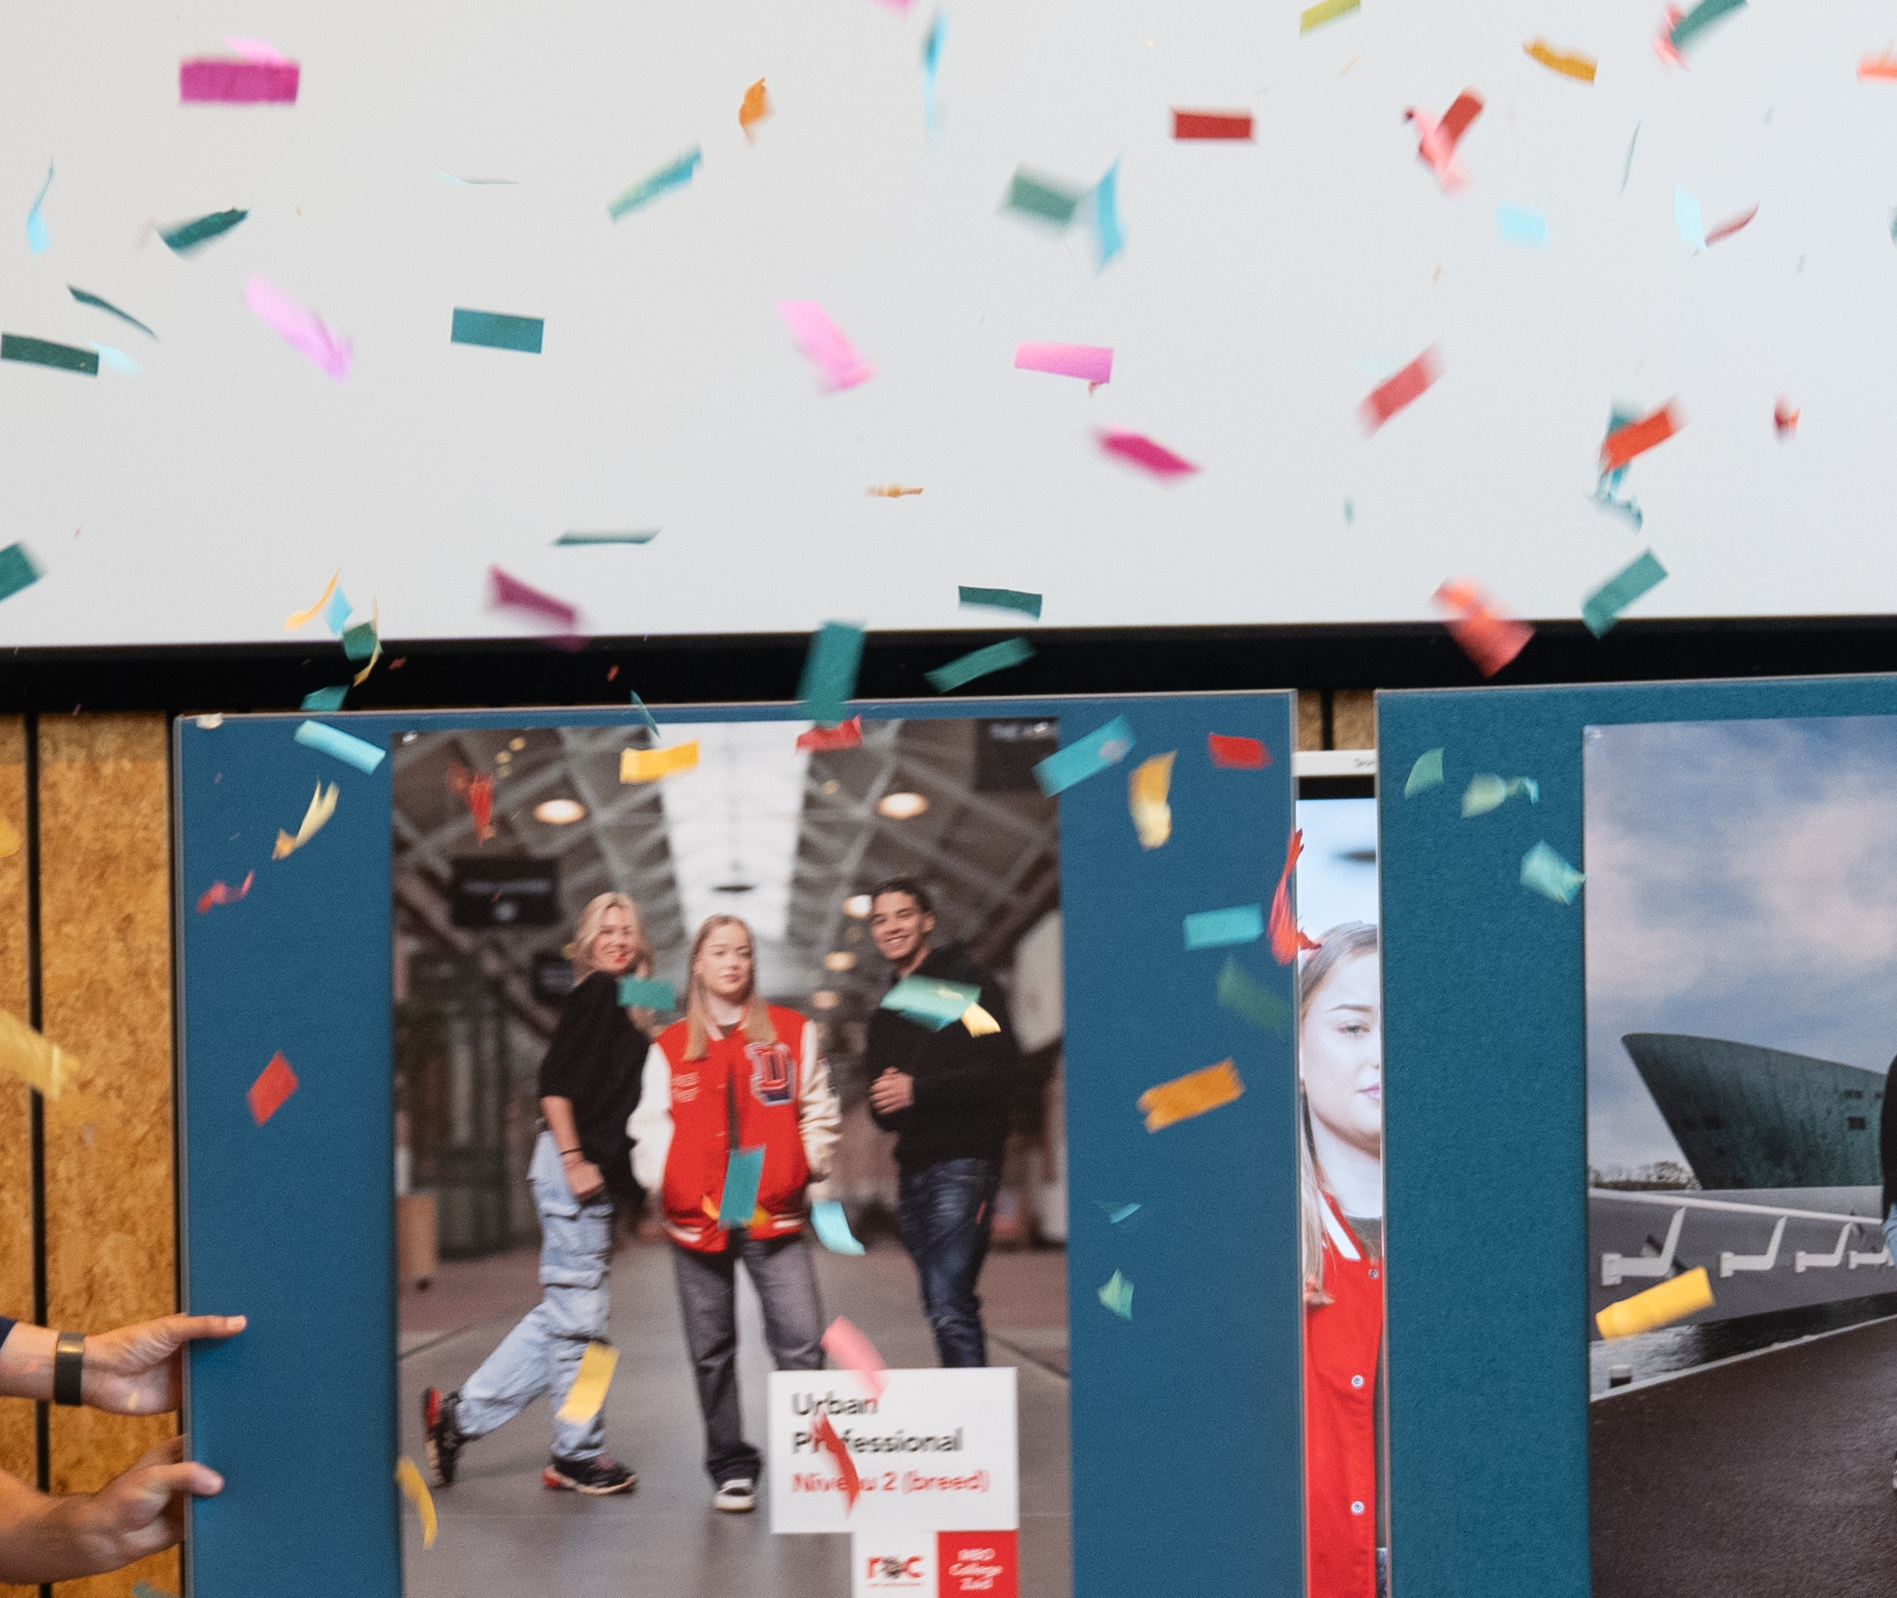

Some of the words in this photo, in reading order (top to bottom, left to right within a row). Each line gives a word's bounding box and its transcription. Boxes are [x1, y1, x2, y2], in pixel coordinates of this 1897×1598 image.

[792, 1392, 878, 1415] Urban
[793, 1427, 965, 1454] Prfessional
[792, 1472, 878, 1493] Niveu
[883, 1472, 896, 1491] 2
[902, 1469, 990, 1494] (breed)
